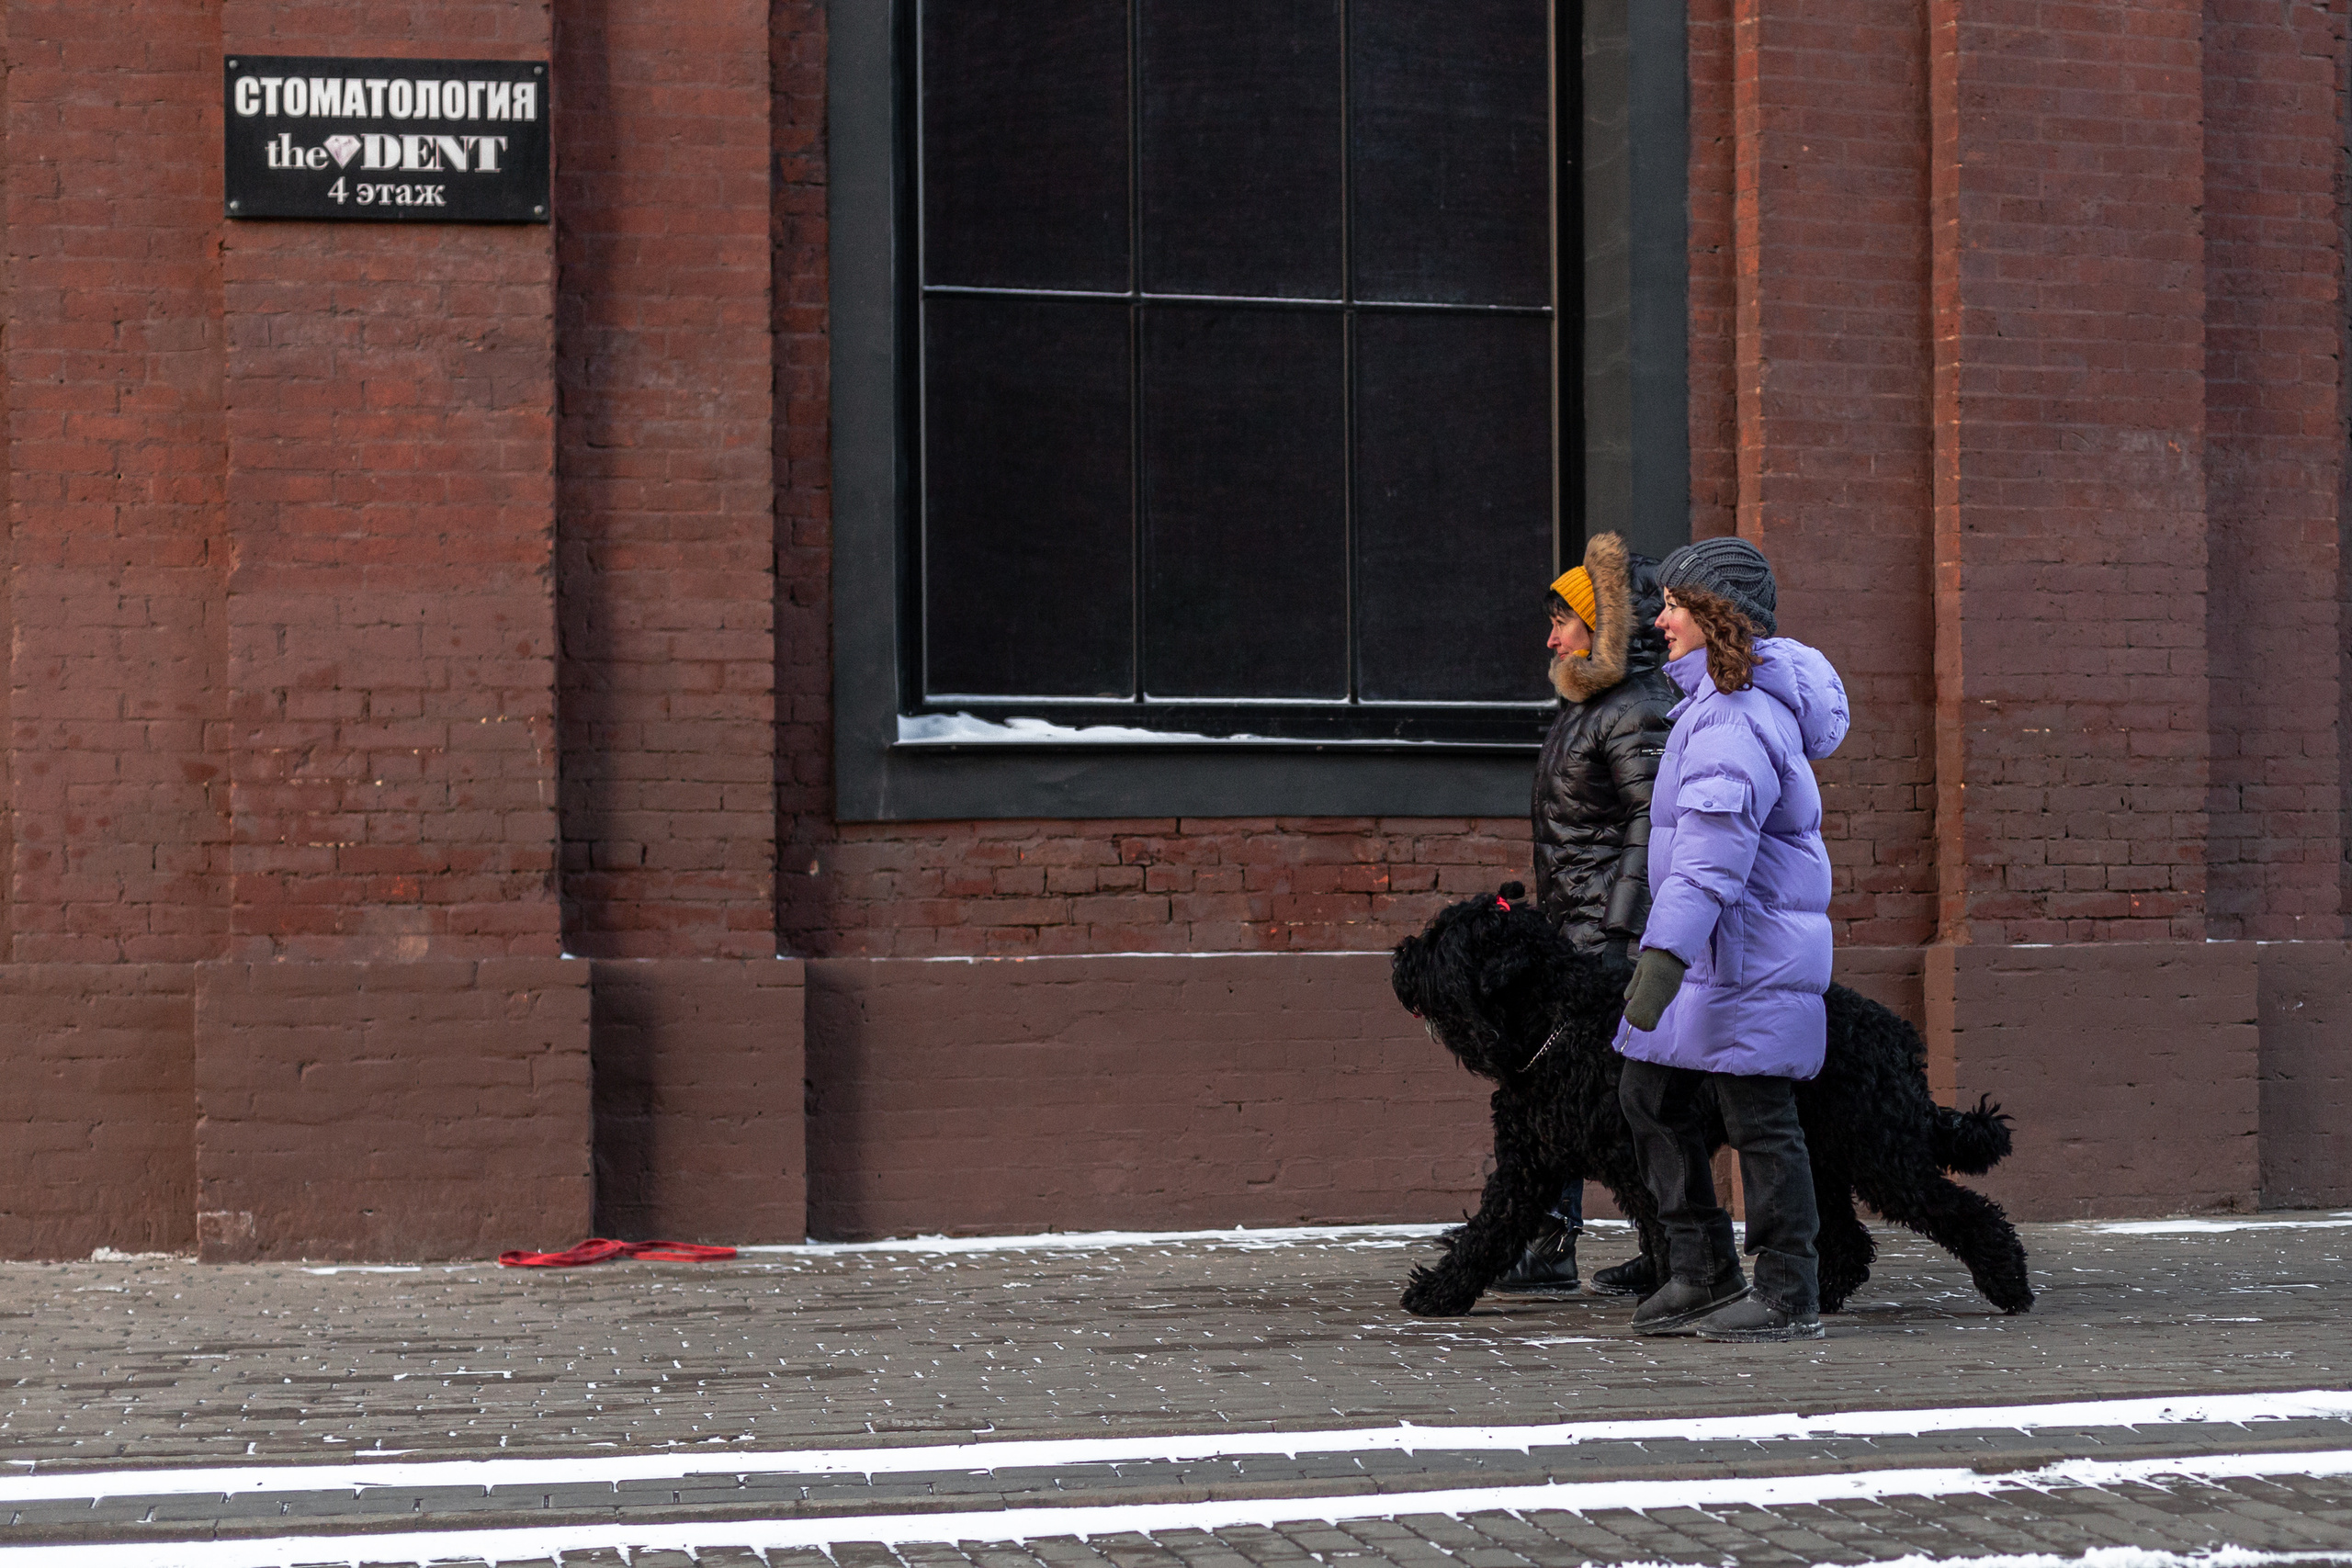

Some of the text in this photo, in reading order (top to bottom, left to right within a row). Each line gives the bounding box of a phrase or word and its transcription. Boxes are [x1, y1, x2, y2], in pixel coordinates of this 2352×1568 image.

[234, 76, 537, 121] СТОМАТОЛОГИЯ
[266, 133, 508, 173] the DENT
[327, 176, 447, 207] 4 этаж
